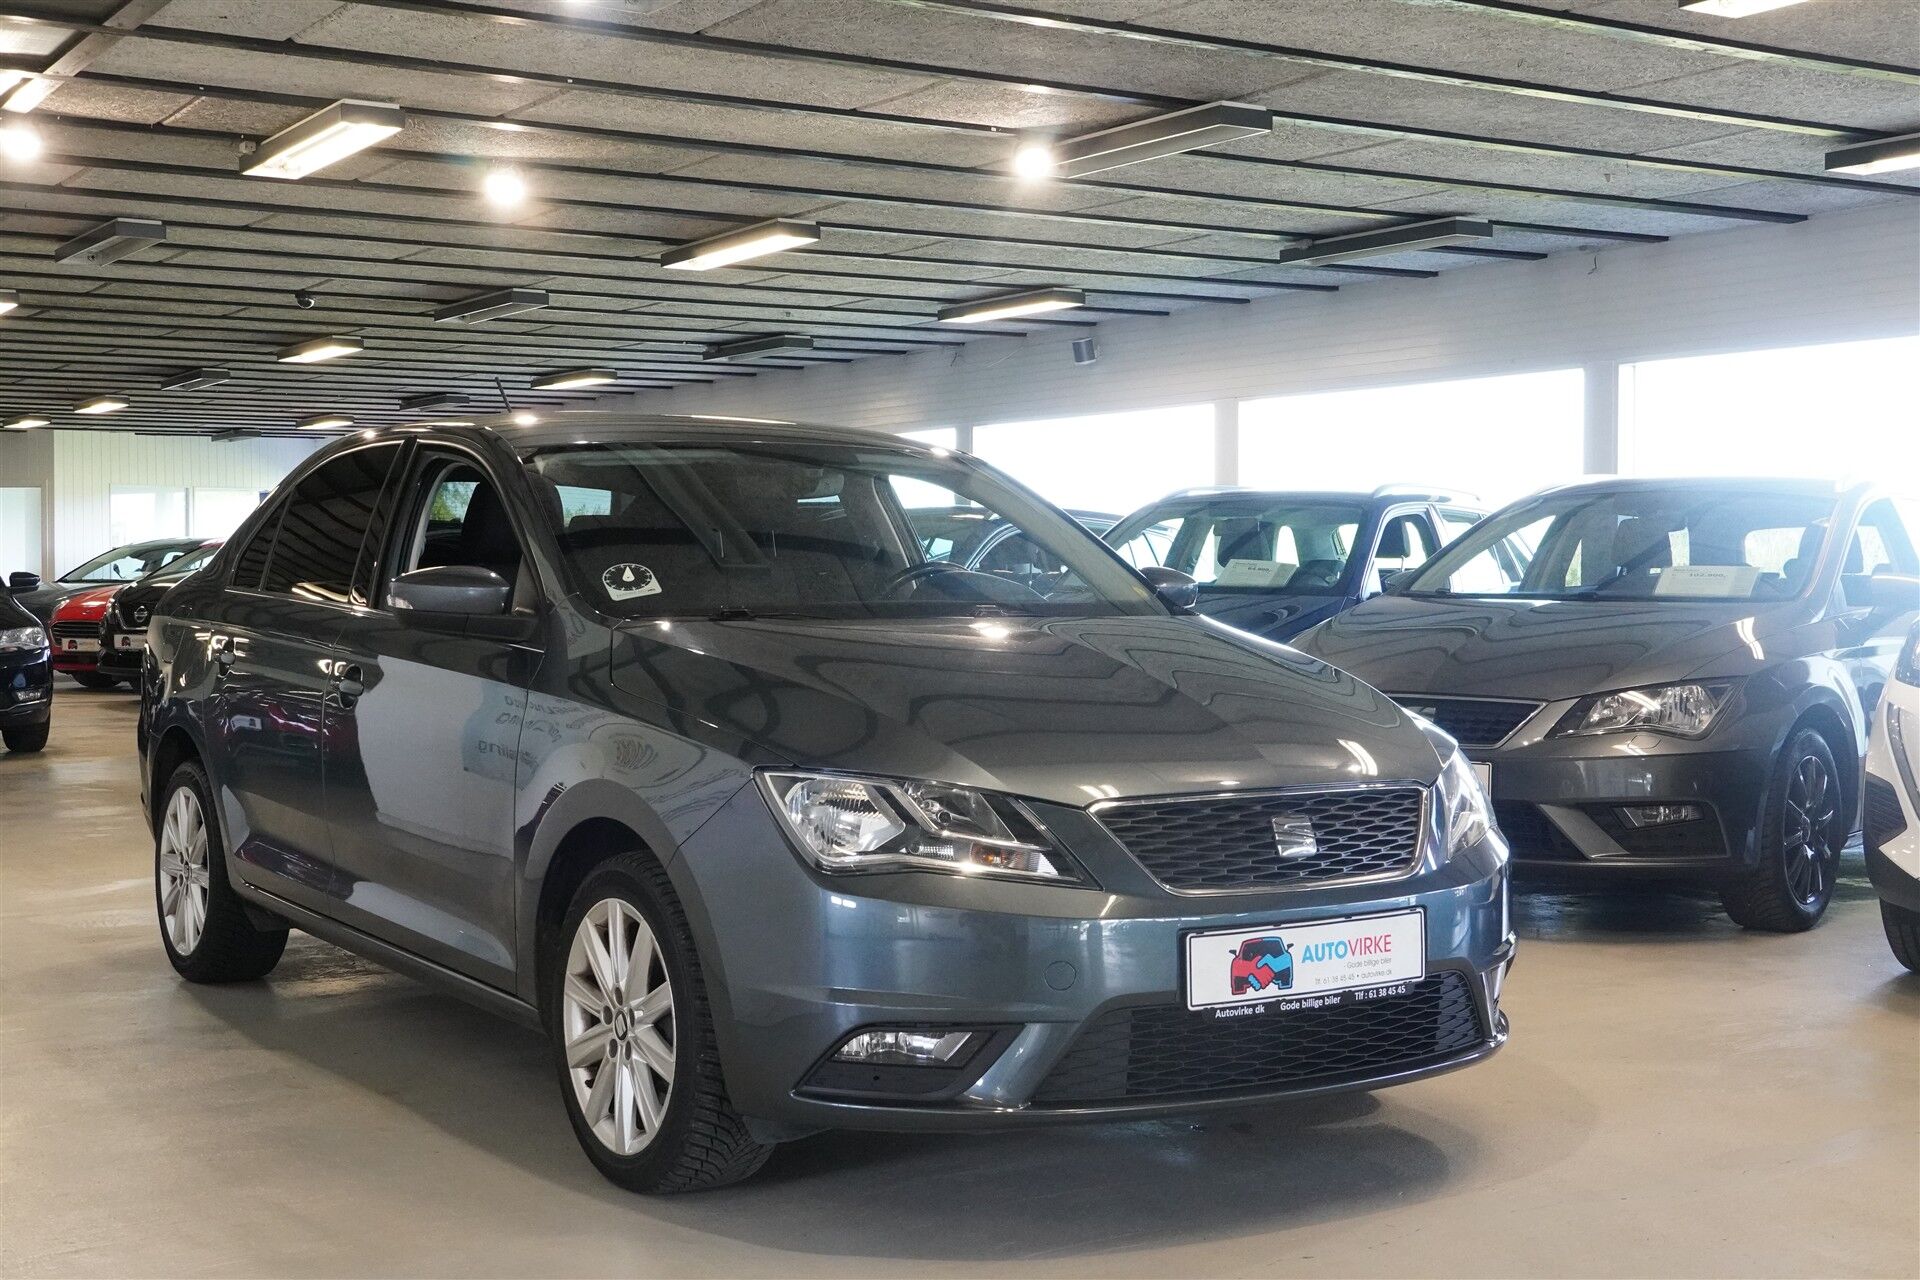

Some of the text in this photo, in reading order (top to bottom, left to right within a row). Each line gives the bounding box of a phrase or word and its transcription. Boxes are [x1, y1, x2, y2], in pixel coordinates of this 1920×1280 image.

[1301, 934, 1392, 964] AUTOVIRKE
[1347, 957, 1392, 969] Gode billige biler
[1280, 1001, 1300, 1010] Gode
[1301, 998, 1323, 1008] billige
[1324, 996, 1341, 1005] biler
[1369, 990, 1377, 999] 61
[1378, 988, 1387, 997] 38
[1388, 986, 1397, 996] 45
[1397, 985, 1406, 994] 45
